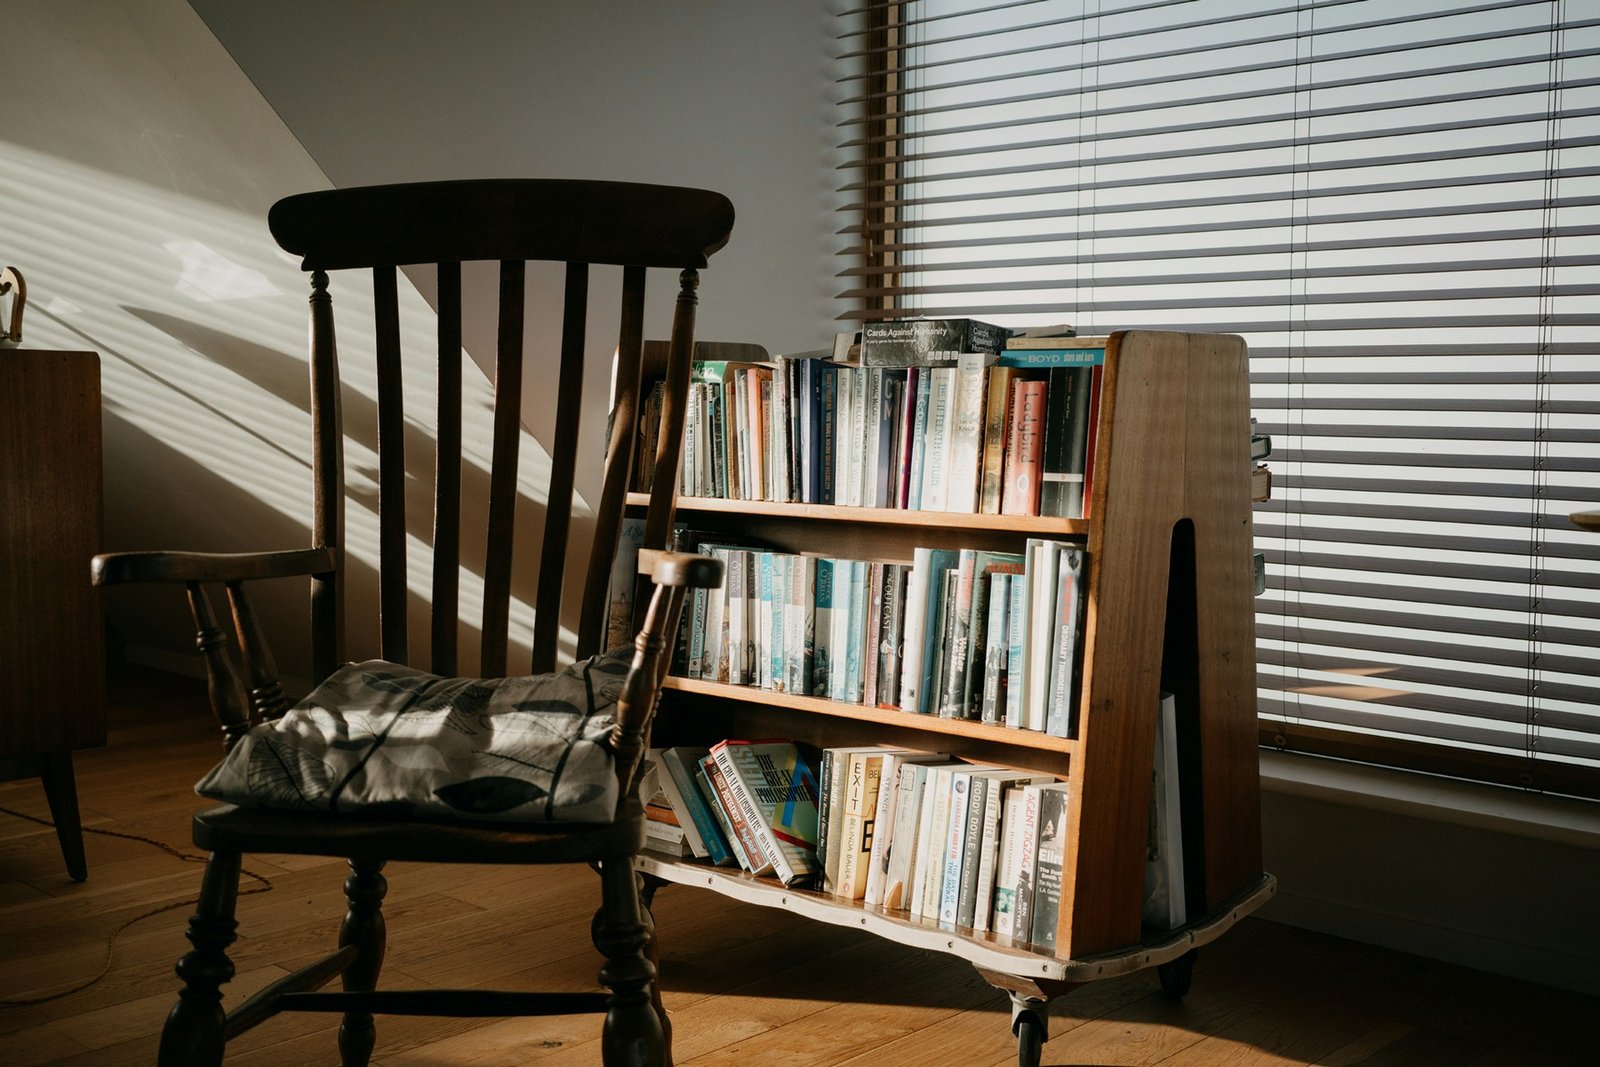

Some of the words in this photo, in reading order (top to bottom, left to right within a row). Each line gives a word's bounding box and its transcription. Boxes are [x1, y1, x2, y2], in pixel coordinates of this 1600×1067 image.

[867, 328, 887, 338] Cards
[889, 327, 914, 338] Against
[914, 326, 948, 337] Humanity
[972, 335, 993, 348] Against
[973, 326, 989, 338] Cards
[1028, 354, 1061, 364] BOYD
[856, 373, 864, 400] EMPIRE
[855, 406, 863, 425] BLUE
[934, 399, 945, 450] FIFTEENTH
[1016, 393, 1040, 464] Ladybird
[824, 438, 832, 455] KNOW
[730, 559, 738, 594] O'BRIAN
[819, 568, 829, 602] O'BRIAN
[882, 585, 893, 630] OUTCAST
[1012, 585, 1021, 604] John
[1012, 608, 1020, 642] Banville
[957, 636, 968, 672] Walter
[1060, 625, 1070, 660] ORDINARY
[1054, 661, 1067, 718] THUNDERSTORMS
[755, 754, 777, 771] THE
[715, 752, 726, 765] THE
[722, 765, 736, 787] GREAT
[733, 786, 763, 832] PHILOSOPHERS
[762, 769, 794, 787] GREAT
[851, 762, 862, 811] EXIT
[755, 785, 812, 803] PHILOSOPHE
[881, 777, 891, 815] STRANGE
[971, 781, 983, 815] RODDY
[987, 787, 997, 811] FEVER
[953, 797, 963, 829] FREDERICK
[1024, 793, 1036, 828] AGENT
[847, 817, 857, 851] BELINDA
[967, 817, 978, 849] DOYLE
[984, 815, 995, 839] PITCH
[951, 831, 960, 859] FORSYTH
[1021, 831, 1033, 868] ZIGZAG
[844, 854, 853, 880] BAUER
[1040, 866, 1050, 874] The
[944, 878, 952, 904] JACKAL
[949, 895, 955, 904] OF
[961, 889, 969, 906] Henry
[1015, 887, 1024, 929] MACINTYRE
